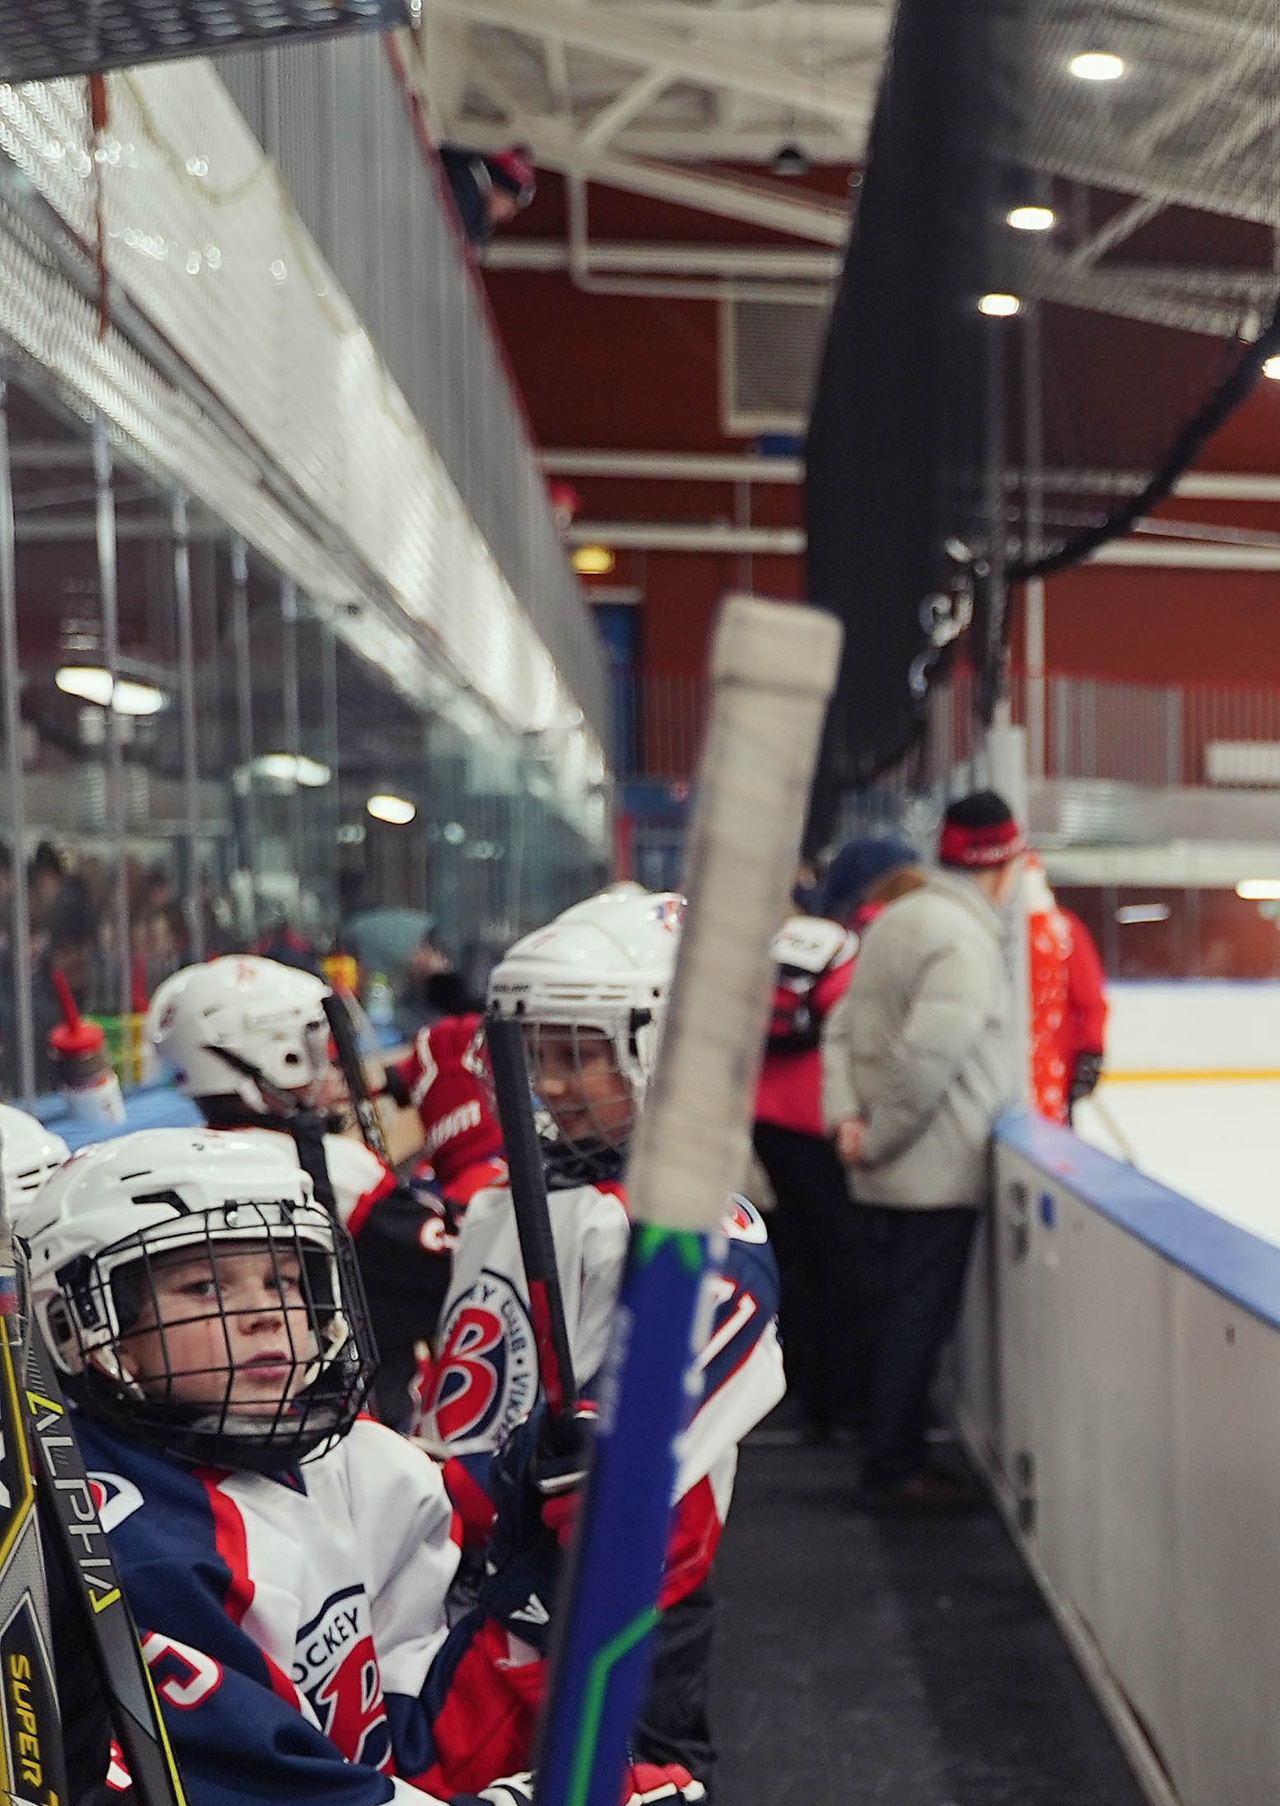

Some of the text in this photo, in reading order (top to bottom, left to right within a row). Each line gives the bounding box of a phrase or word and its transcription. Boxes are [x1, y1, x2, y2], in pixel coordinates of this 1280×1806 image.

[26, 1391, 123, 1614] ALPHA
[291, 1607, 359, 1685] OCKEY
[9, 1652, 43, 1789] SUPER
